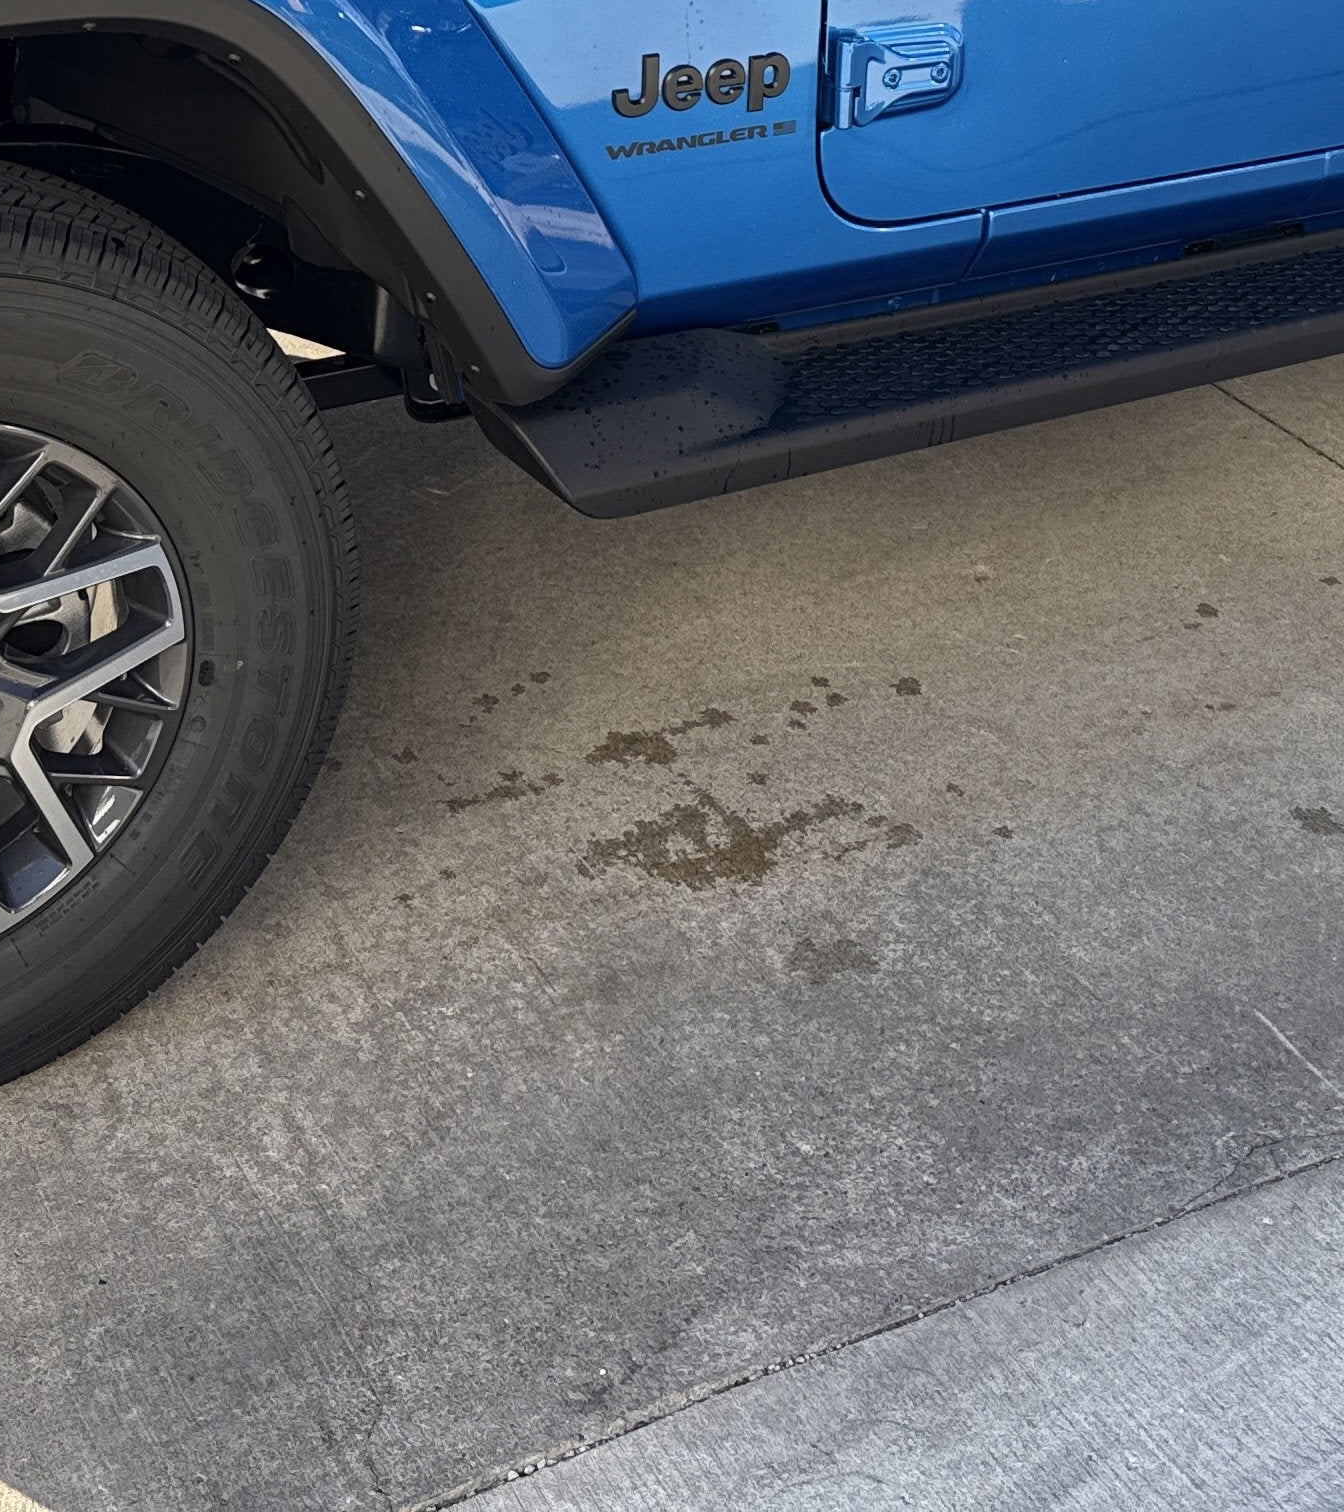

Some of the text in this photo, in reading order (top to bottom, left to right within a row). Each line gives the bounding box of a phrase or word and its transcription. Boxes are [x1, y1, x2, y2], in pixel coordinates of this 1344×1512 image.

[612, 52, 790, 118] Jeep
[605, 124, 768, 161] WRANGLER
[54, 351, 298, 894] BRIDGESTONE
